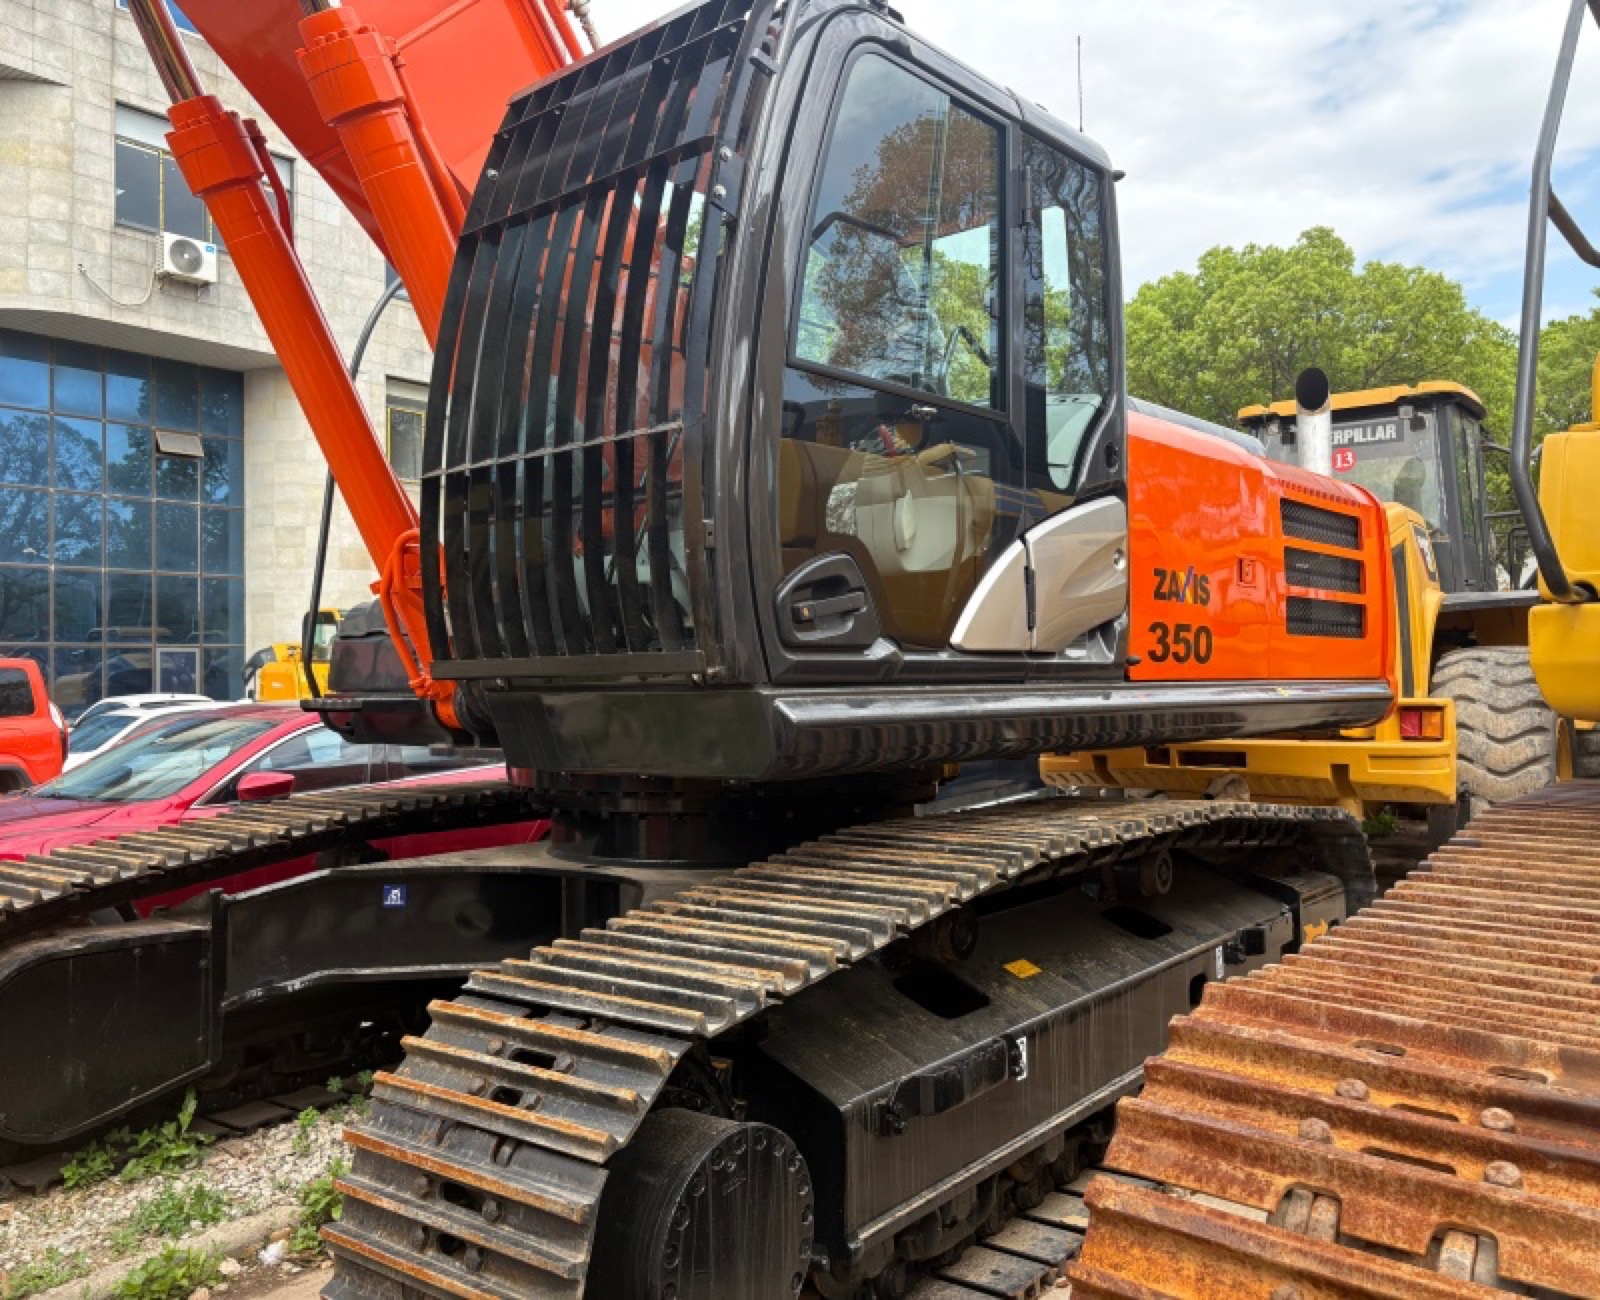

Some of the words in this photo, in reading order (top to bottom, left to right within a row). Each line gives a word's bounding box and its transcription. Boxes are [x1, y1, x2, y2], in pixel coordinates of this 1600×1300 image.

[1335, 452, 1354, 468] 13
[1153, 566, 1211, 606] ZAXIS
[1148, 622, 1213, 664] 350
